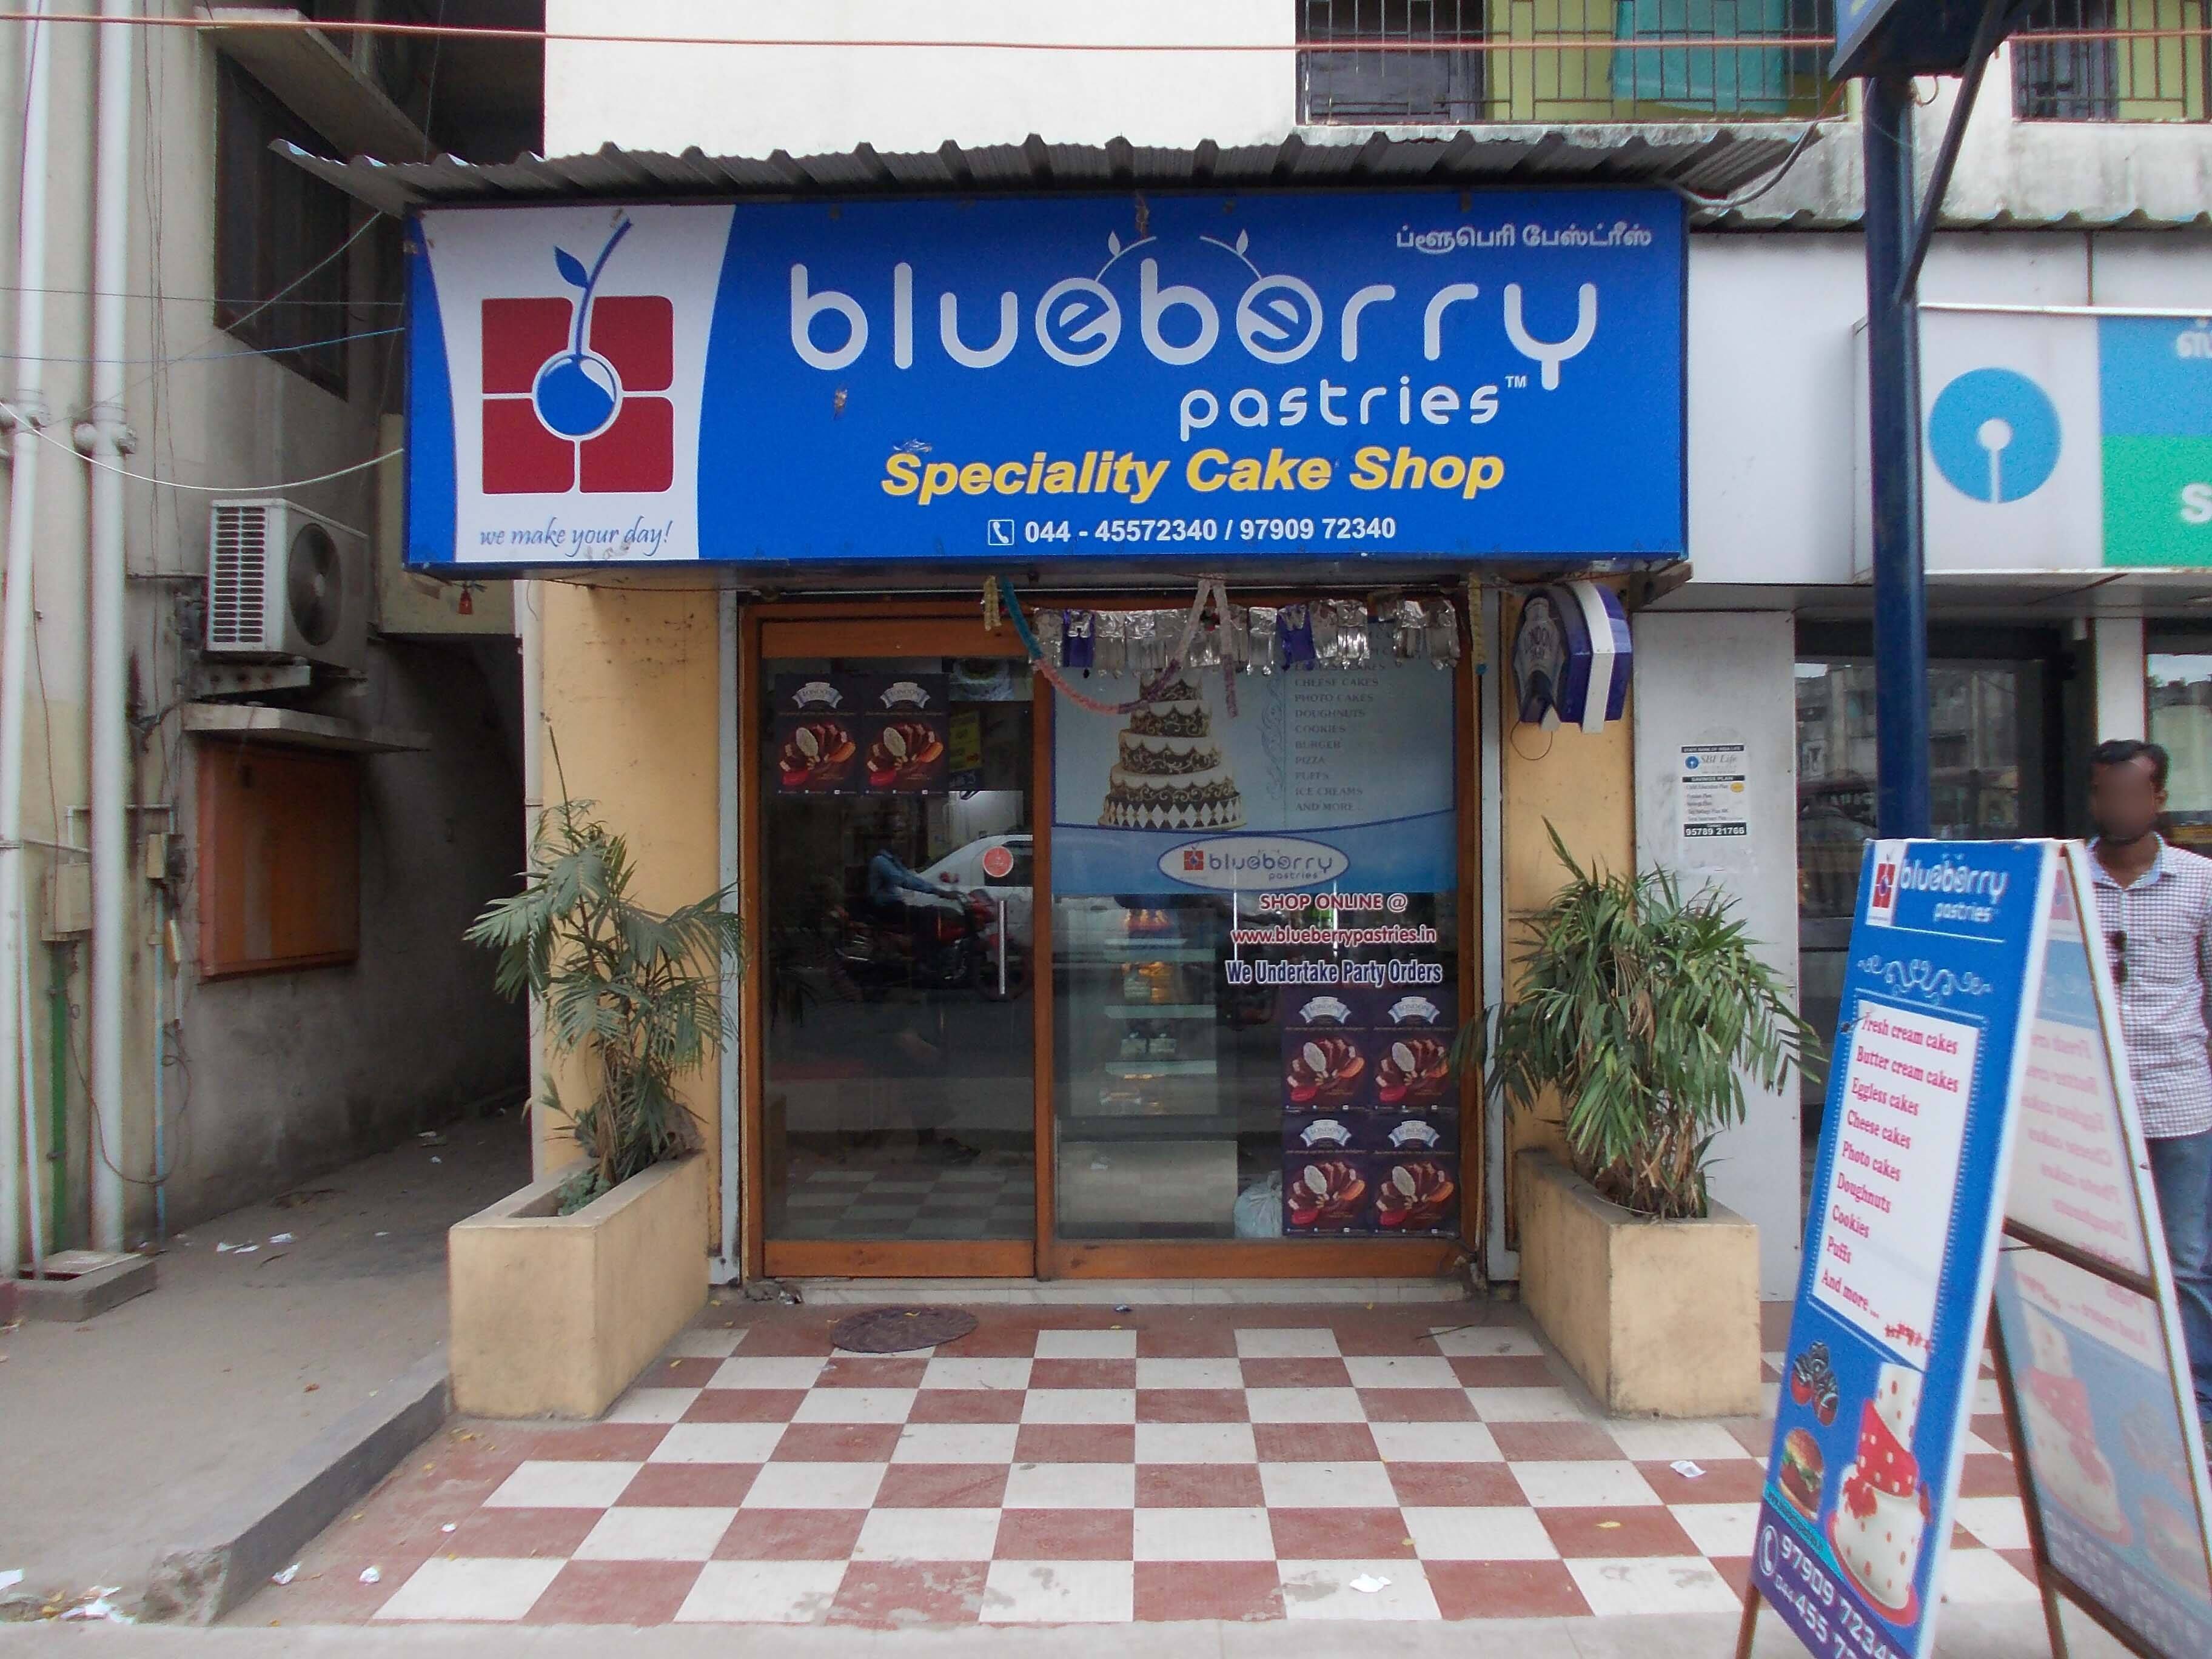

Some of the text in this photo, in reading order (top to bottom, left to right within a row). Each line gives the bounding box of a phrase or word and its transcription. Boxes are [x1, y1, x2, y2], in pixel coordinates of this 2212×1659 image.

[791, 257, 1597, 390] blueberry
[1180, 376, 1499, 441] pastries
[881, 446, 1504, 506] Speciality Cake Shop
[480, 515, 674, 557] we make your day!
[1025, 521, 1071, 543] 044
[1094, 519, 1217, 542] 45572340
[1239, 518, 1315, 540] 97909
[1322, 517, 1396, 539] 72340
[1295, 694, 1333, 702] PHOTO
[1295, 709, 1366, 718] DOUGHNUTS
[1295, 756, 1326, 765] PIZZA
[1295, 802, 1319, 811] AND
[1209, 853, 1333, 874] blueberry
[1268, 871, 1319, 881] pastries
[1900, 859, 2009, 904] blueberry
[1259, 893, 1408, 913] SHOP ONLINE @
[1933, 902, 1993, 922] pastries
[1230, 924, 1436, 947] www.blueberrypastries.in
[1225, 959, 1443, 988] We Undertake Party Orders
[1861, 1012, 1959, 1054] Fresh cream cakes
[1856, 1045, 1960, 1093] Butter cream cakes
[1851, 1077, 1920, 1116] Eggless cakes
[1847, 1109, 1911, 1150] Cheese cakes
[1842, 1141, 1902, 1182] Photo cakes
[1837, 1171, 1892, 1213] Doughnuts
[1832, 1204, 1870, 1238] Cookies
[1826, 1235, 1852, 1264] Puffs
[1821, 1269, 1842, 1293] And
[1843, 1285, 1869, 1312] more
[1780, 1535, 1898, 1659] 97909 7234
[1795, 1594, 1827, 1643] 455
